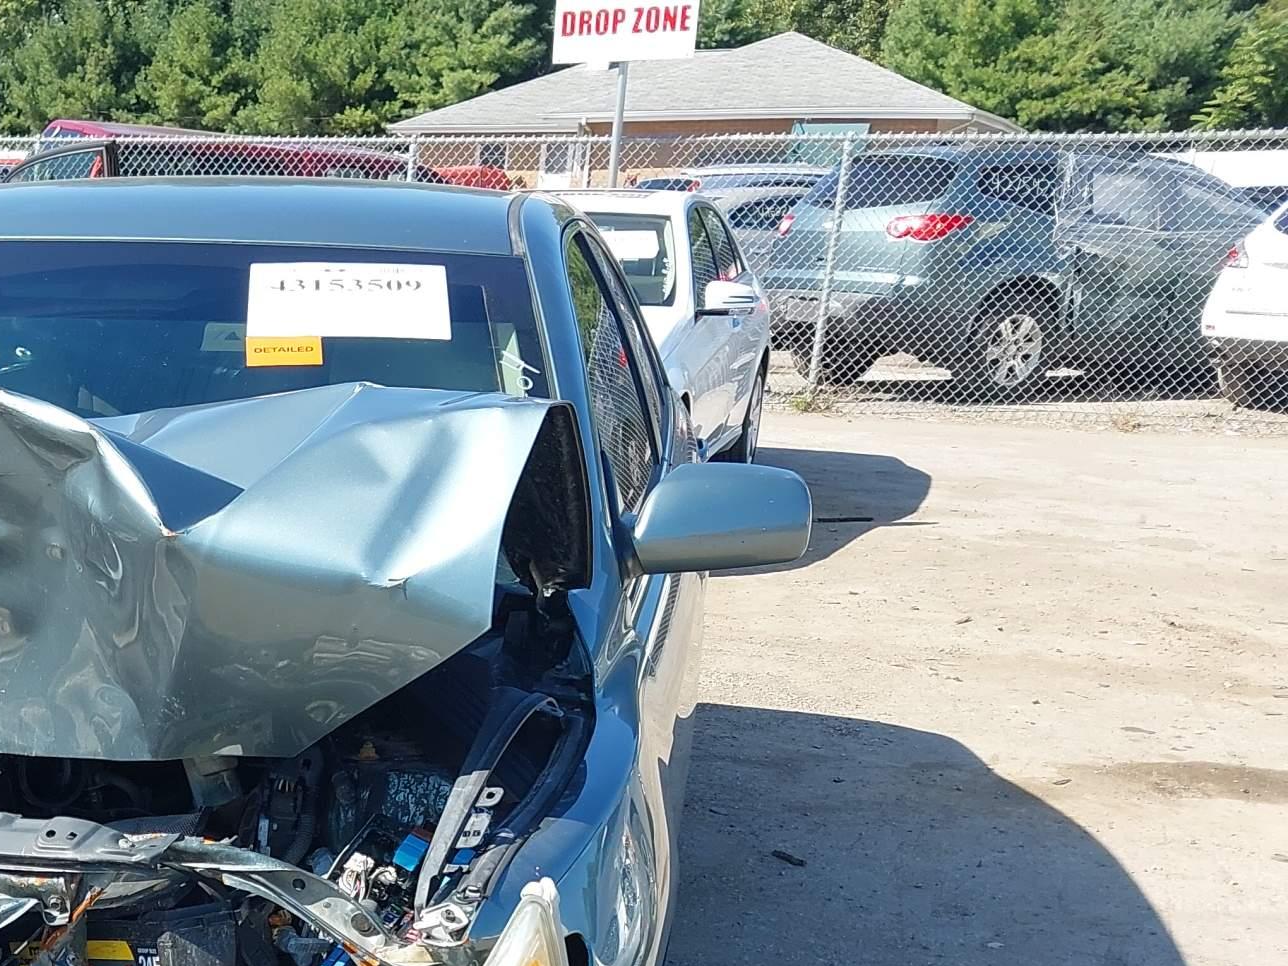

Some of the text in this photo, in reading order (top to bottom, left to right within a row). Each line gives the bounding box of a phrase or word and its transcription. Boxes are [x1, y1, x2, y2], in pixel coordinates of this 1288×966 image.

[561, 5, 692, 37] DROP ZONE
[270, 279, 422, 292] 43153509
[253, 345, 314, 354] DETAILED
